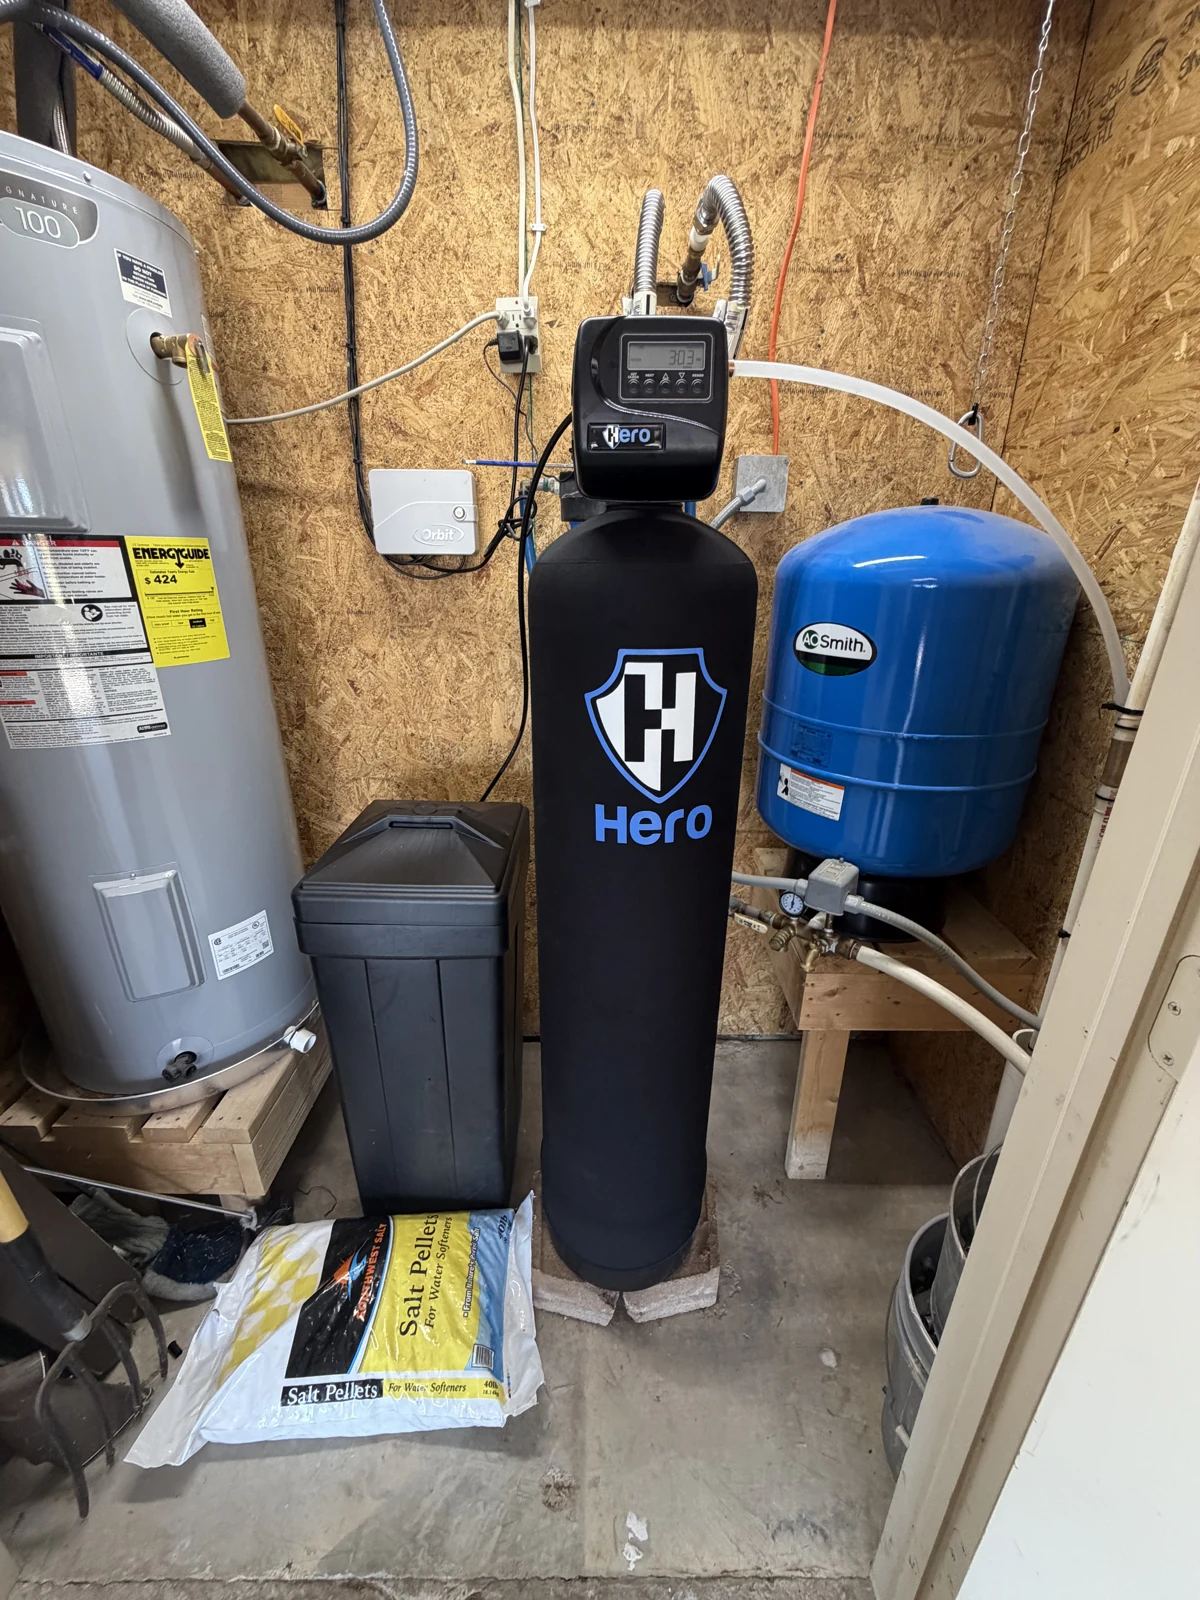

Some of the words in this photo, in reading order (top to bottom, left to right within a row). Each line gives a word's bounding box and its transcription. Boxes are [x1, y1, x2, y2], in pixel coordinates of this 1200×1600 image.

[14, 206, 61, 238] 100
[142, 268, 152, 277] NOT
[668, 350, 694, 365] 3:03
[421, 528, 454, 542] Orbit
[132, 547, 210, 560] ENERGYGUIDE
[144, 577, 151, 585] $
[154, 575, 177, 584] 424
[803, 632, 820, 646] AO
[820, 635, 863, 652] Smith
[595, 803, 712, 846] Hero
[374, 1223, 387, 1242] SALT
[436, 1217, 452, 1260] Softeners
[410, 1214, 439, 1276] Pellets
[429, 1265, 443, 1301] Water
[463, 1290, 472, 1310] From
[400, 1285, 424, 1336] Salt
[424, 1306, 436, 1328] For
[287, 1386, 320, 1405] Salt
[324, 1382, 378, 1401] Pellets
[388, 1382, 401, 1392] For
[404, 1383, 428, 1392] Water
[430, 1382, 467, 1394] Softeners
[484, 1380, 498, 1389] 40lb
